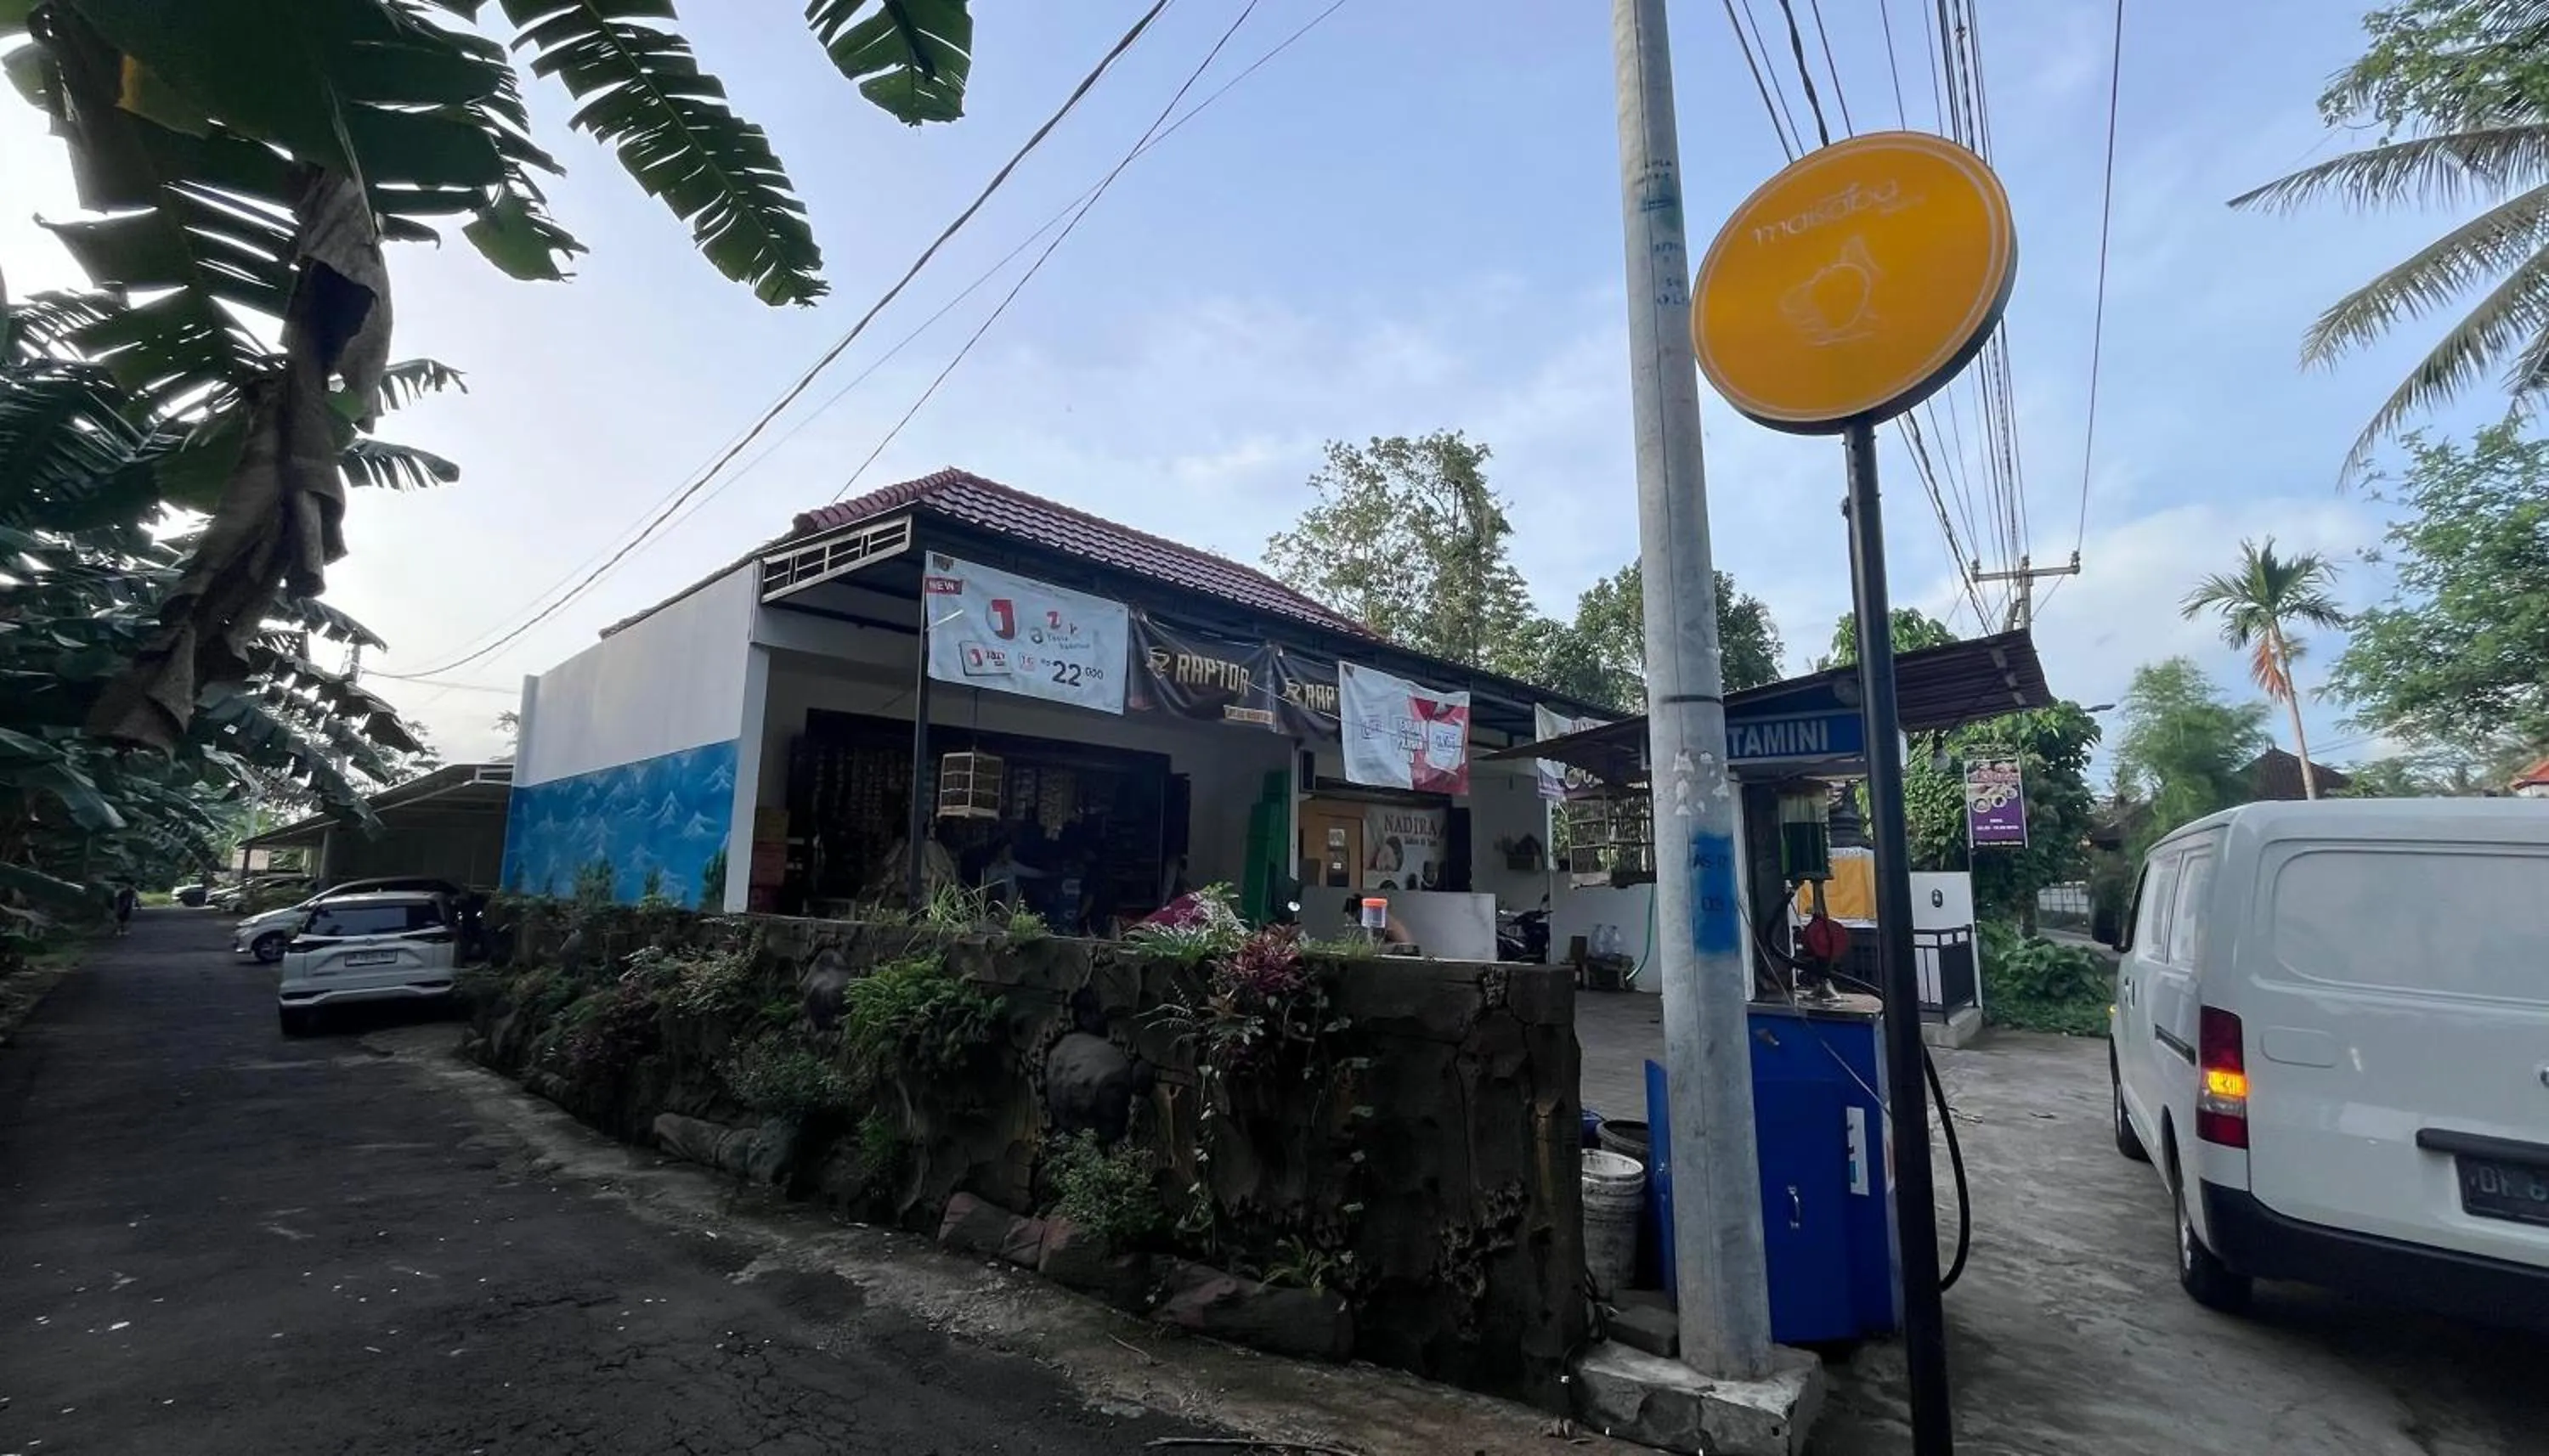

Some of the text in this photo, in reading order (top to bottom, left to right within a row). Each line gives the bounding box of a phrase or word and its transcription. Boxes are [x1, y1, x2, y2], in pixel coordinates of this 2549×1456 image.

[1052, 660, 1082, 686] 22
[1175, 652, 1250, 697] RAPTOR
[1727, 720, 1829, 757] TAMINI
